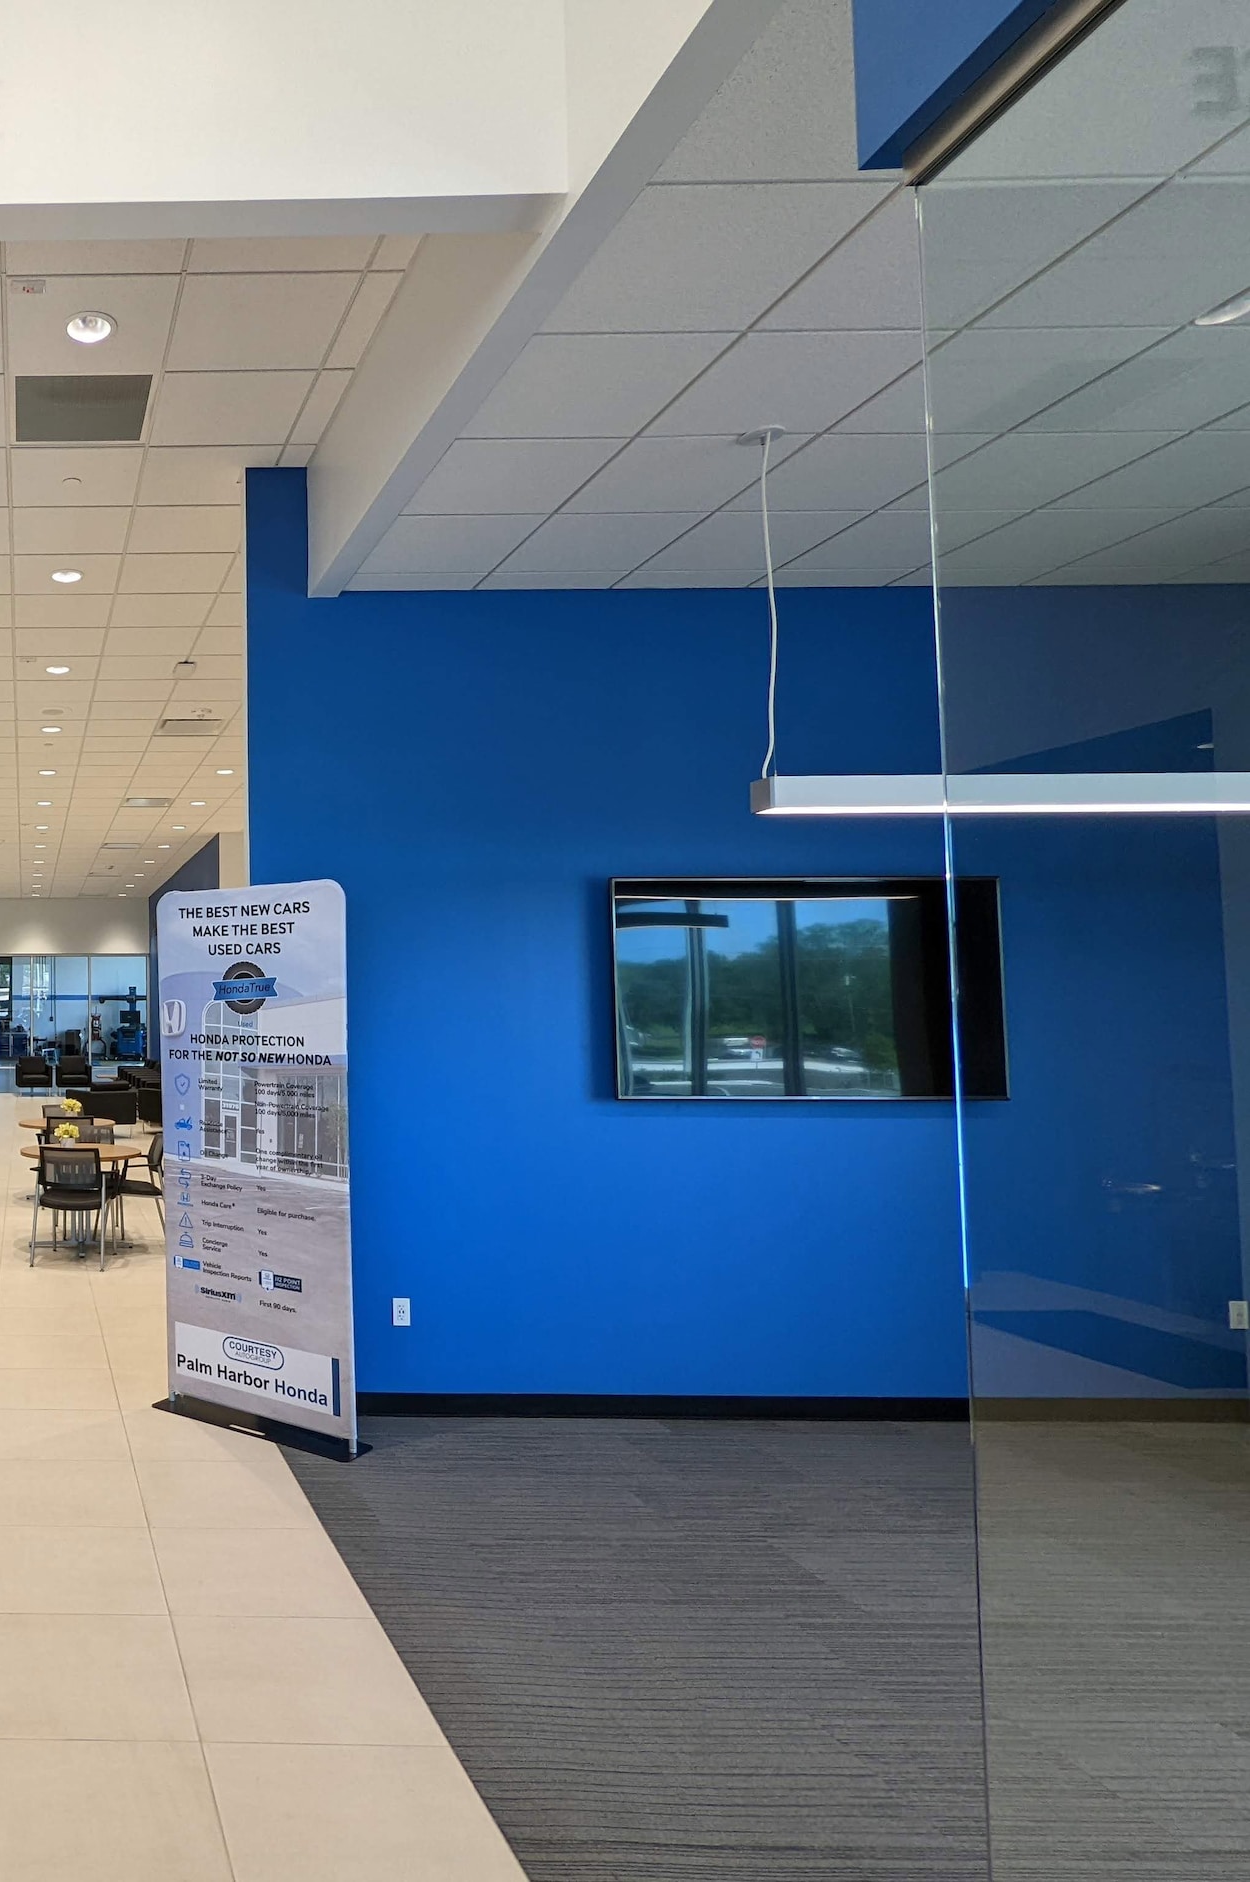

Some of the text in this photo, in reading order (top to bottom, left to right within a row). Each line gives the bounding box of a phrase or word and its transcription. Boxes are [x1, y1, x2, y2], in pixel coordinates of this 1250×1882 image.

[179, 901, 311, 919] THE BEST NEW CARS
[192, 922, 295, 937] MAKE THE BEST
[208, 942, 281, 956] USED CARS
[218, 982, 271, 994] HondaTrue
[237, 1020, 253, 1028] Used
[190, 1033, 305, 1047] HONDA PROTECTION
[169, 1049, 332, 1065] FOR THE NOT SO NEW HONDA
[254, 1080, 313, 1091] Powertrain Coverage
[200, 1181, 243, 1192] Exchange Policy
[201, 1199, 219, 1208] Honda
[257, 1207, 277, 1216] Eligible
[201, 1219, 245, 1232] Trip Interruption
[202, 1237, 228, 1248] Concierge
[202, 1244, 221, 1252] Service
[202, 1260, 222, 1269] Vehicle
[202, 1269, 229, 1278] Inspection
[230, 1272, 252, 1282] Reports
[259, 1299, 272, 1308] First
[273, 1302, 281, 1310] 90
[229, 1340, 277, 1359] COURTESY
[177, 1354, 328, 1407] Palm Harbor Honda
